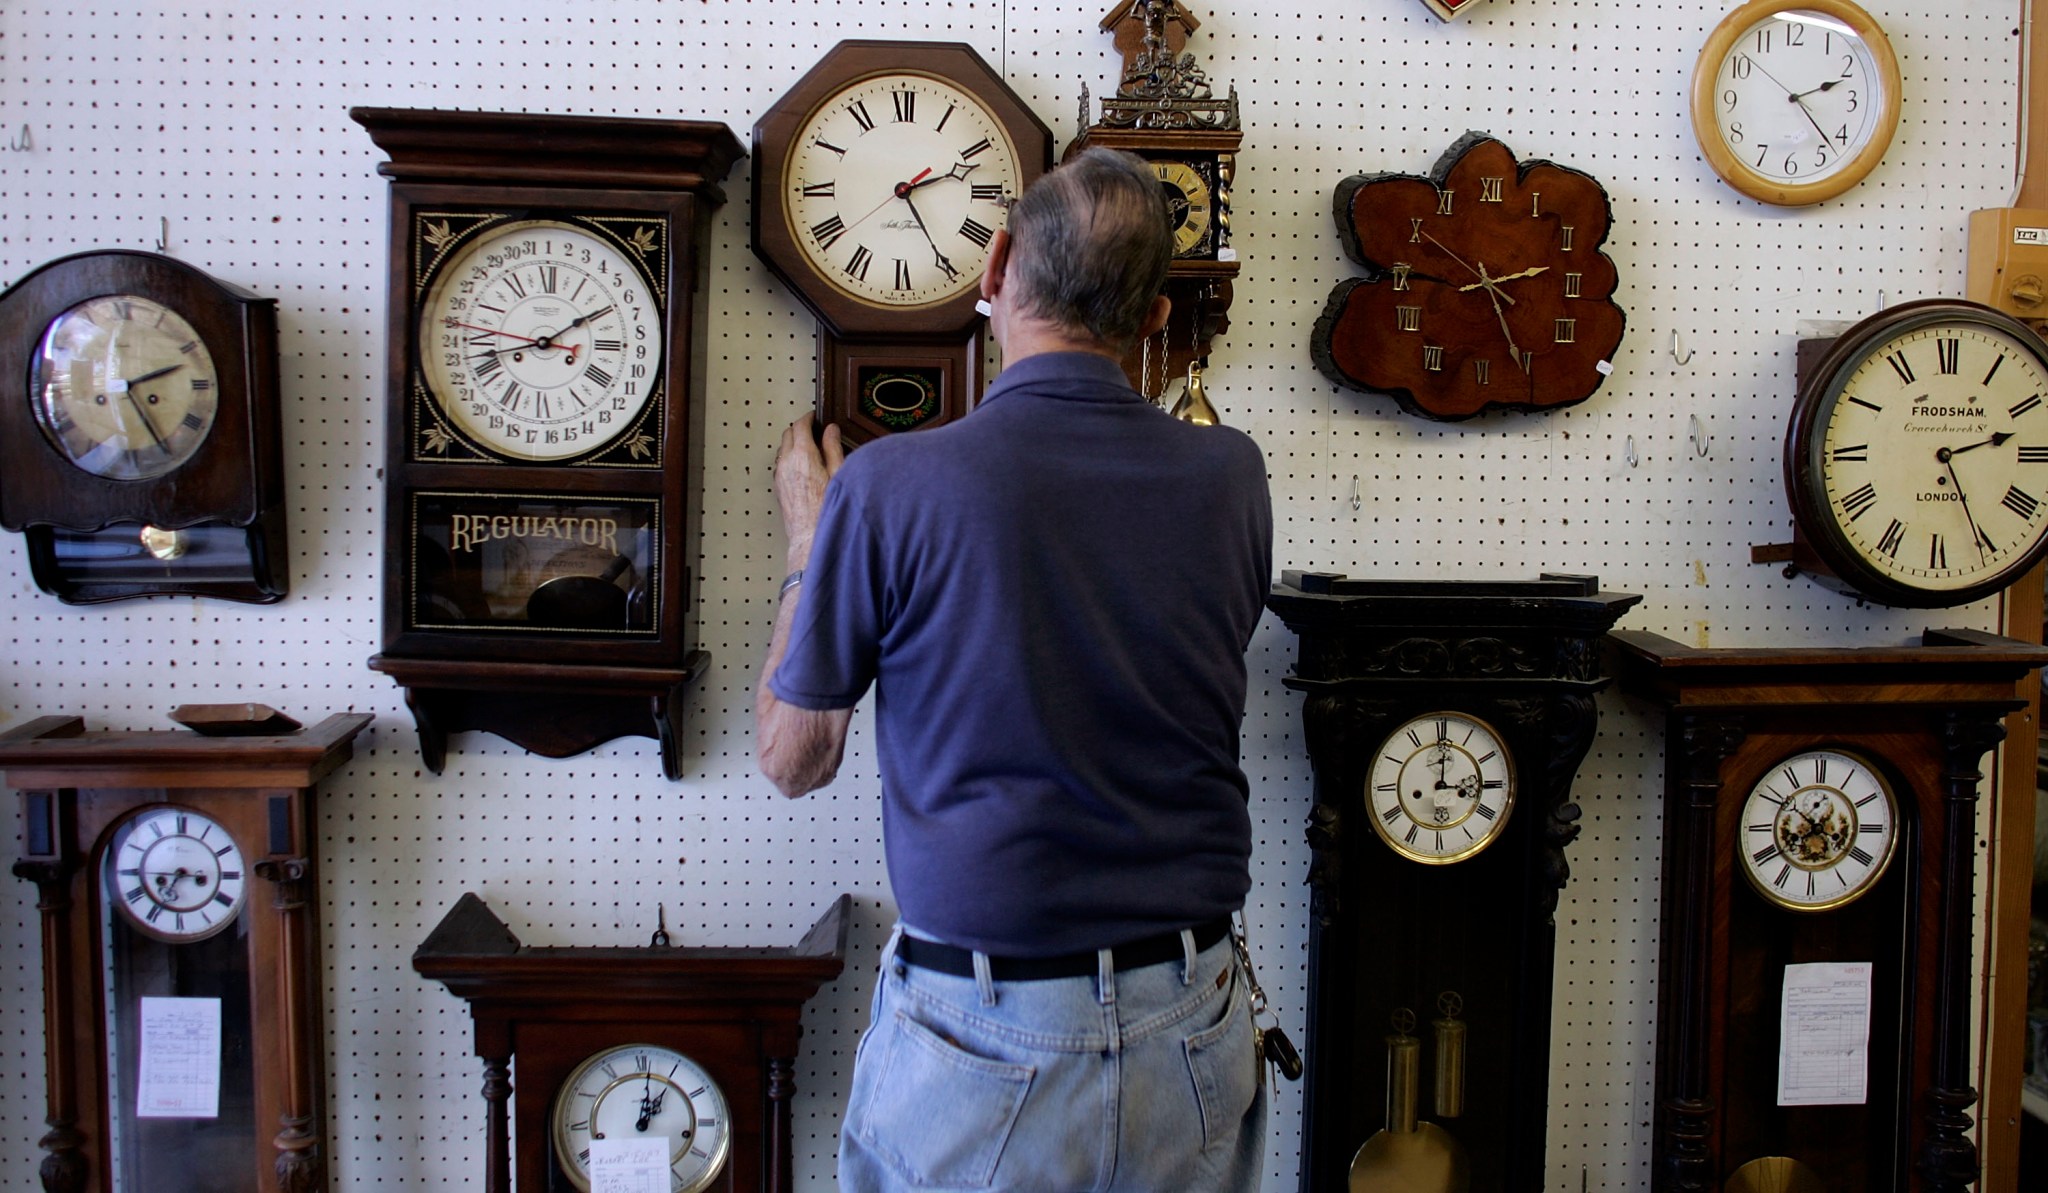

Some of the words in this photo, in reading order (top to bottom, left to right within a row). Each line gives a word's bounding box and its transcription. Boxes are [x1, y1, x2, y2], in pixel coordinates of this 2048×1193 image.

[1787, 23, 1803, 46] 12
[1757, 30, 1770, 53] 11
[1826, 32, 1830, 55] 1
[1733, 56, 1750, 79] 10
[1841, 55, 1853, 77] 2
[1724, 90, 1736, 113] 9
[1847, 90, 1857, 112] 3
[1731, 122, 1743, 143] 8
[1835, 124, 1847, 145] 4
[1757, 145, 1768, 167] 7
[1815, 145, 1826, 167] 5
[1784, 152, 1797, 175] 6
[1480, 178, 1503, 201] XII
[1437, 191, 1454, 214] XI
[1532, 193, 1539, 217] I
[1409, 219, 1423, 242] X
[1561, 227, 1574, 250] II
[504, 246, 521, 260] 30
[522, 241, 537, 254] 31
[545, 241, 551, 254] 1
[564, 243, 573, 256] 2
[487, 253, 503, 267] 29
[581, 250, 591, 263] 3
[472, 266, 488, 279] 28
[598, 260, 608, 273] 4
[613, 273, 623, 286] 5
[1393, 265, 1410, 290] IX
[461, 281, 474, 294] 27
[1565, 273, 1582, 297] III
[624, 290, 633, 303] 6
[451, 298, 466, 310] 26
[632, 307, 640, 320] 7
[1396, 306, 1421, 331] VIII
[635, 326, 646, 339] 8
[1555, 319, 1576, 342] IIII
[442, 335, 458, 347] 24
[636, 346, 646, 359] 9
[1423, 346, 1443, 370] VII
[445, 353, 461, 366] 23
[1522, 352, 1532, 375] V
[631, 365, 645, 378] 10
[1475, 360, 1489, 384] VI
[451, 373, 466, 385] 22
[460, 389, 474, 401] 21
[624, 382, 636, 395] 11
[473, 403, 488, 415] 20
[612, 398, 626, 410] 12
[600, 410, 611, 423] 13
[1912, 406, 1987, 418] FRODSHAM.
[490, 415, 503, 428] 19
[582, 421, 594, 434] 14
[1903, 422, 1973, 433] Gracechurch
[507, 424, 520, 437] 18
[526, 429, 537, 442] 17
[545, 430, 558, 443] 16
[564, 428, 577, 441] 15
[452, 514, 619, 556] REGULATOR
